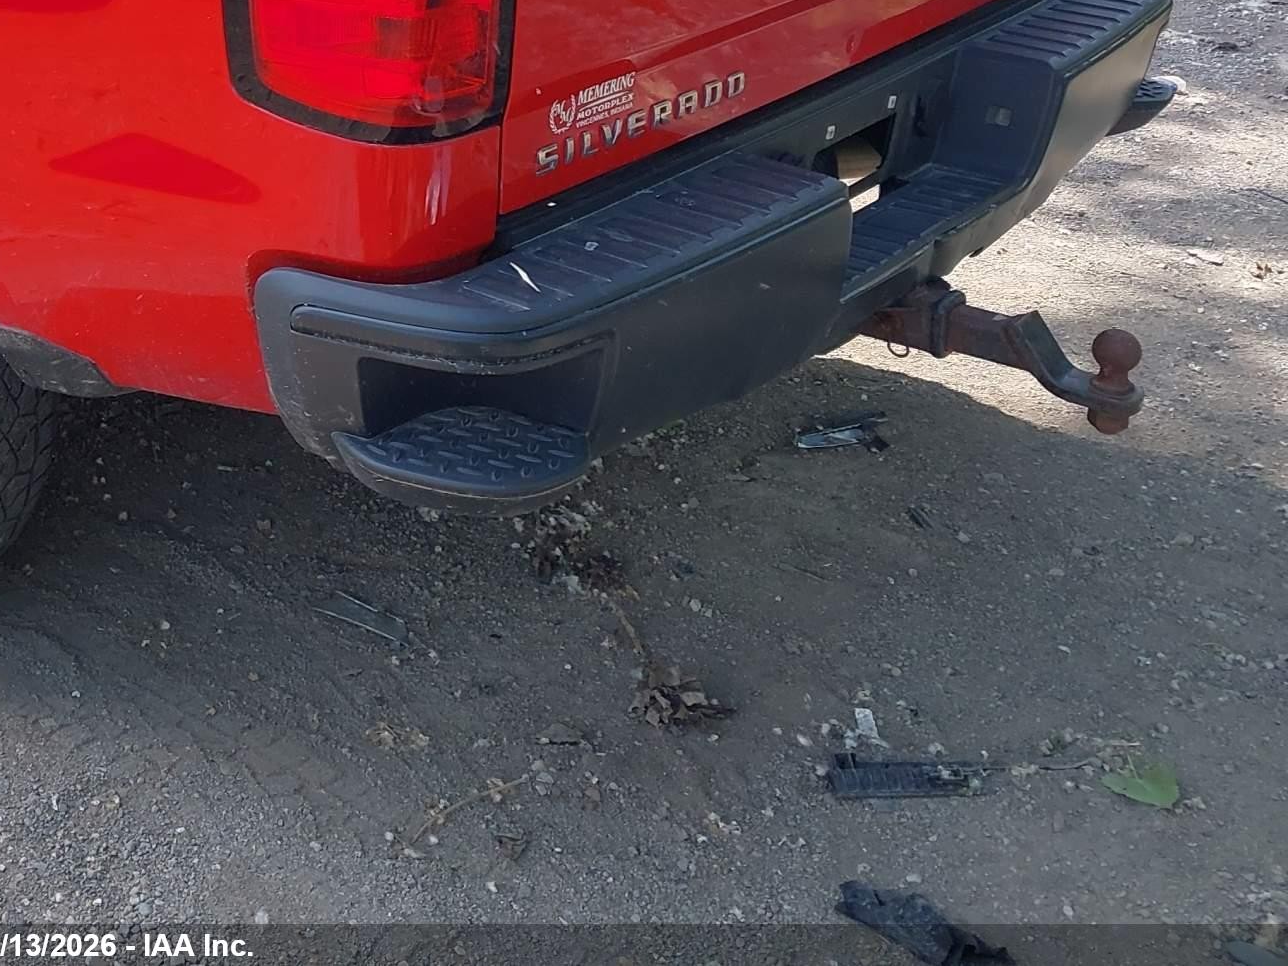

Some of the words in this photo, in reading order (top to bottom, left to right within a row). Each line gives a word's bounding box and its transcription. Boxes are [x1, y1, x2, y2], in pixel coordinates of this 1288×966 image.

[577, 71, 636, 106] MEMERING
[536, 71, 745, 177] SILVERADO
[576, 92, 635, 121] MOTORPLEX
